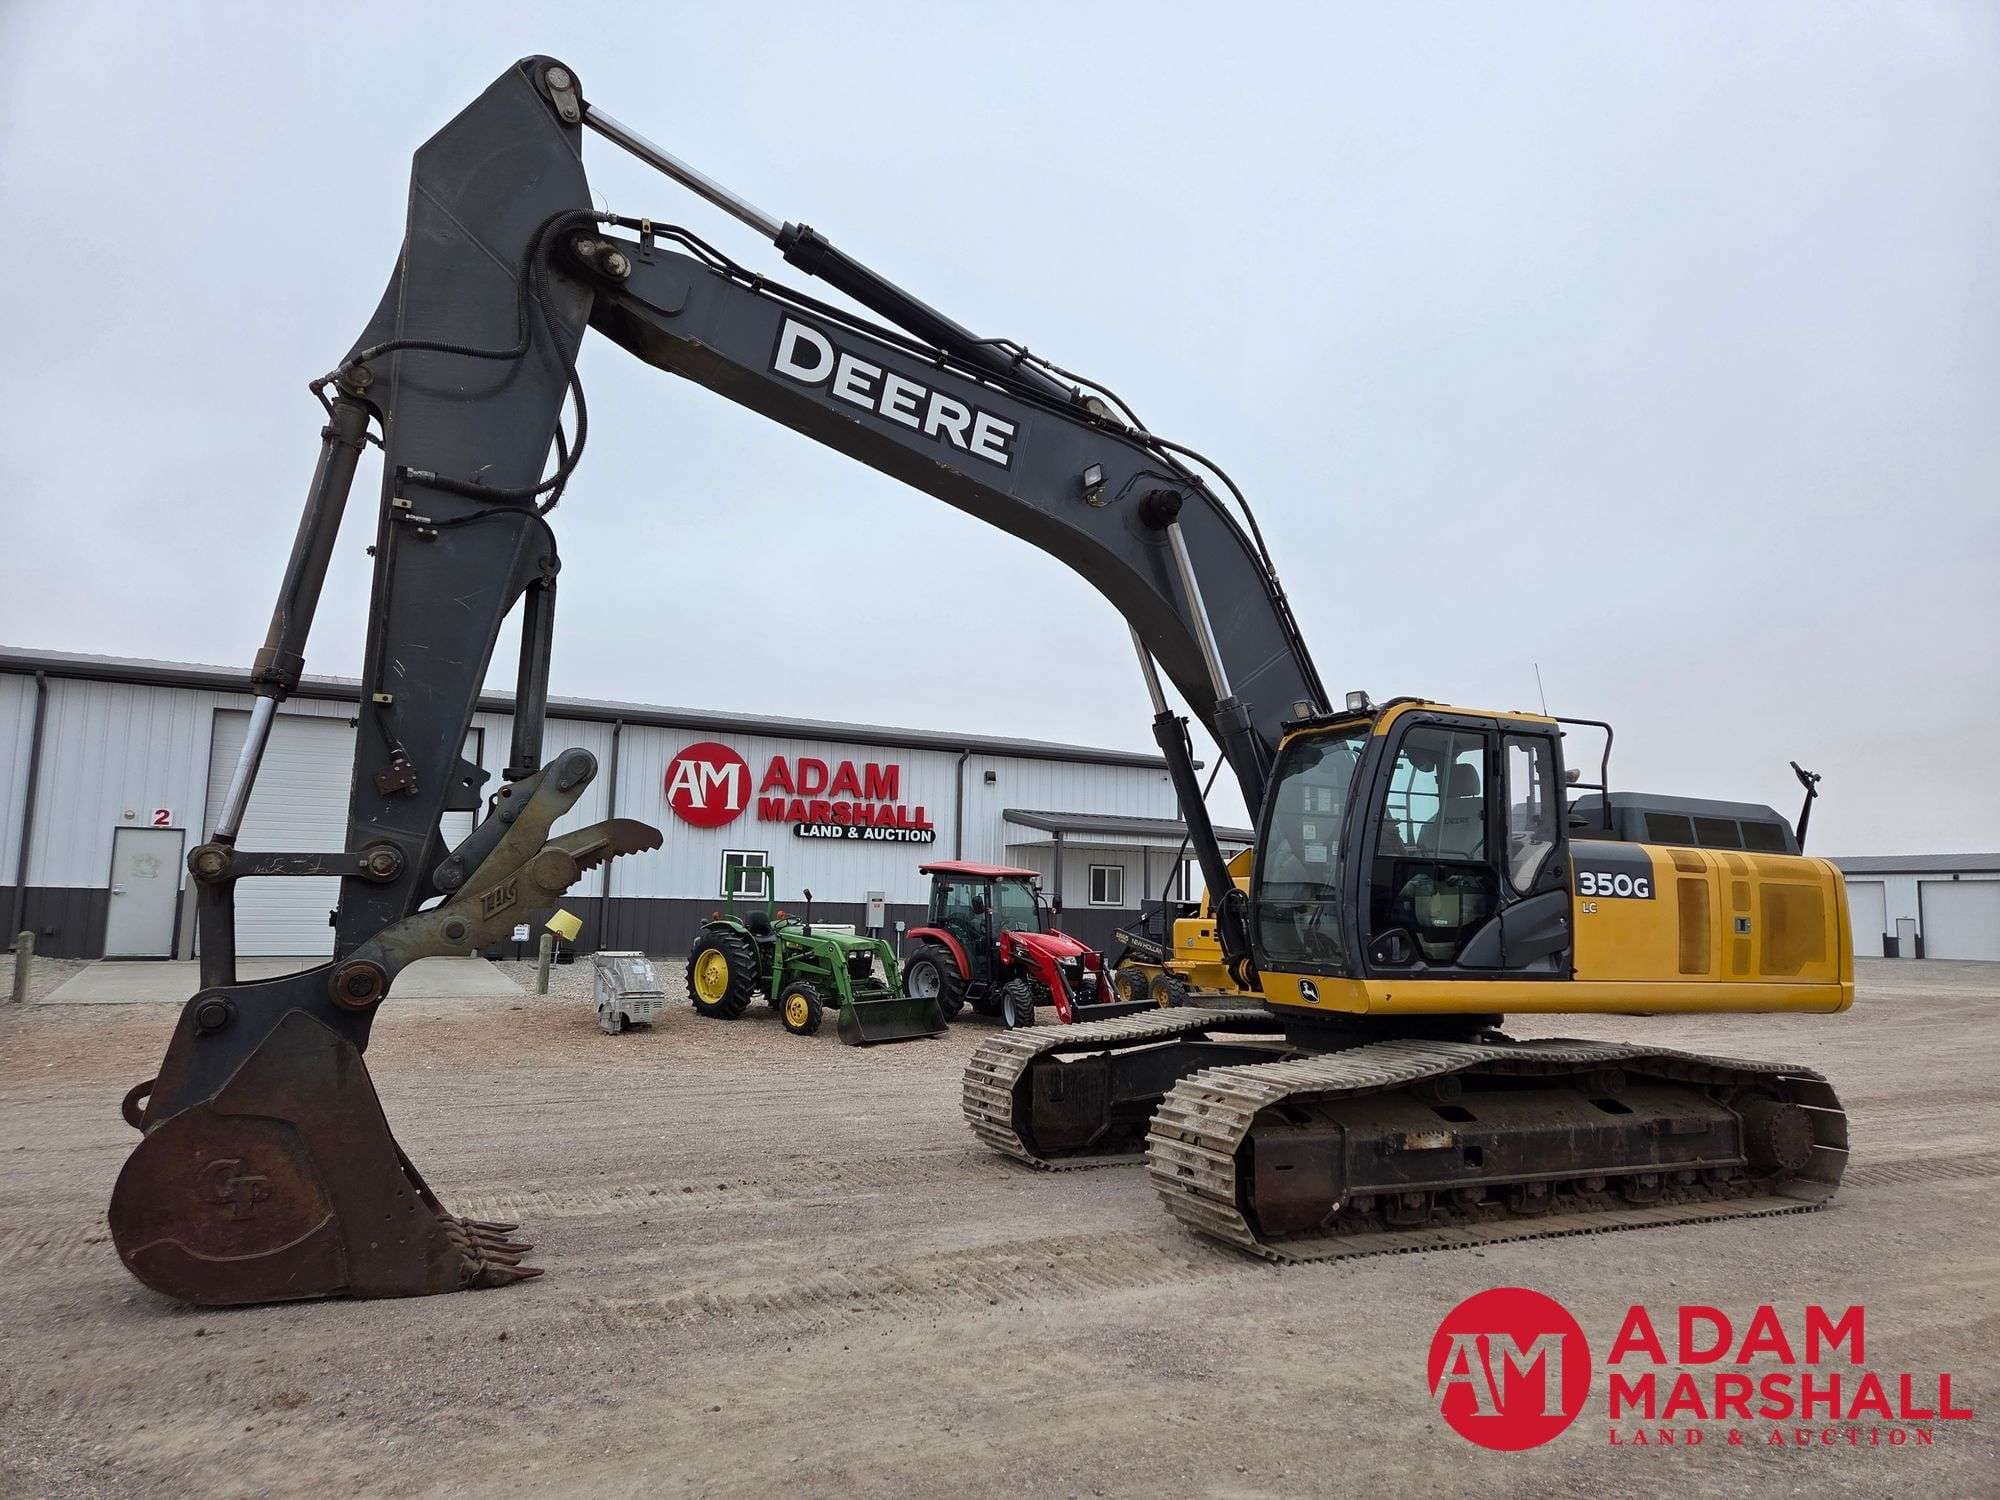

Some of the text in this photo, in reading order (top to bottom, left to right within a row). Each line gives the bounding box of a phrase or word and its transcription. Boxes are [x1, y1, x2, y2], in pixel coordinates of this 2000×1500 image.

[774, 318, 1015, 466] DEERE
[667, 759, 743, 810] AM
[759, 755, 900, 801] ADAM
[153, 809, 170, 825] 2
[758, 797, 934, 828] MARSHALL
[799, 824, 932, 842] LAND & AUCTION
[1579, 872, 1650, 898] 350G
[1582, 902, 1598, 913] LC
